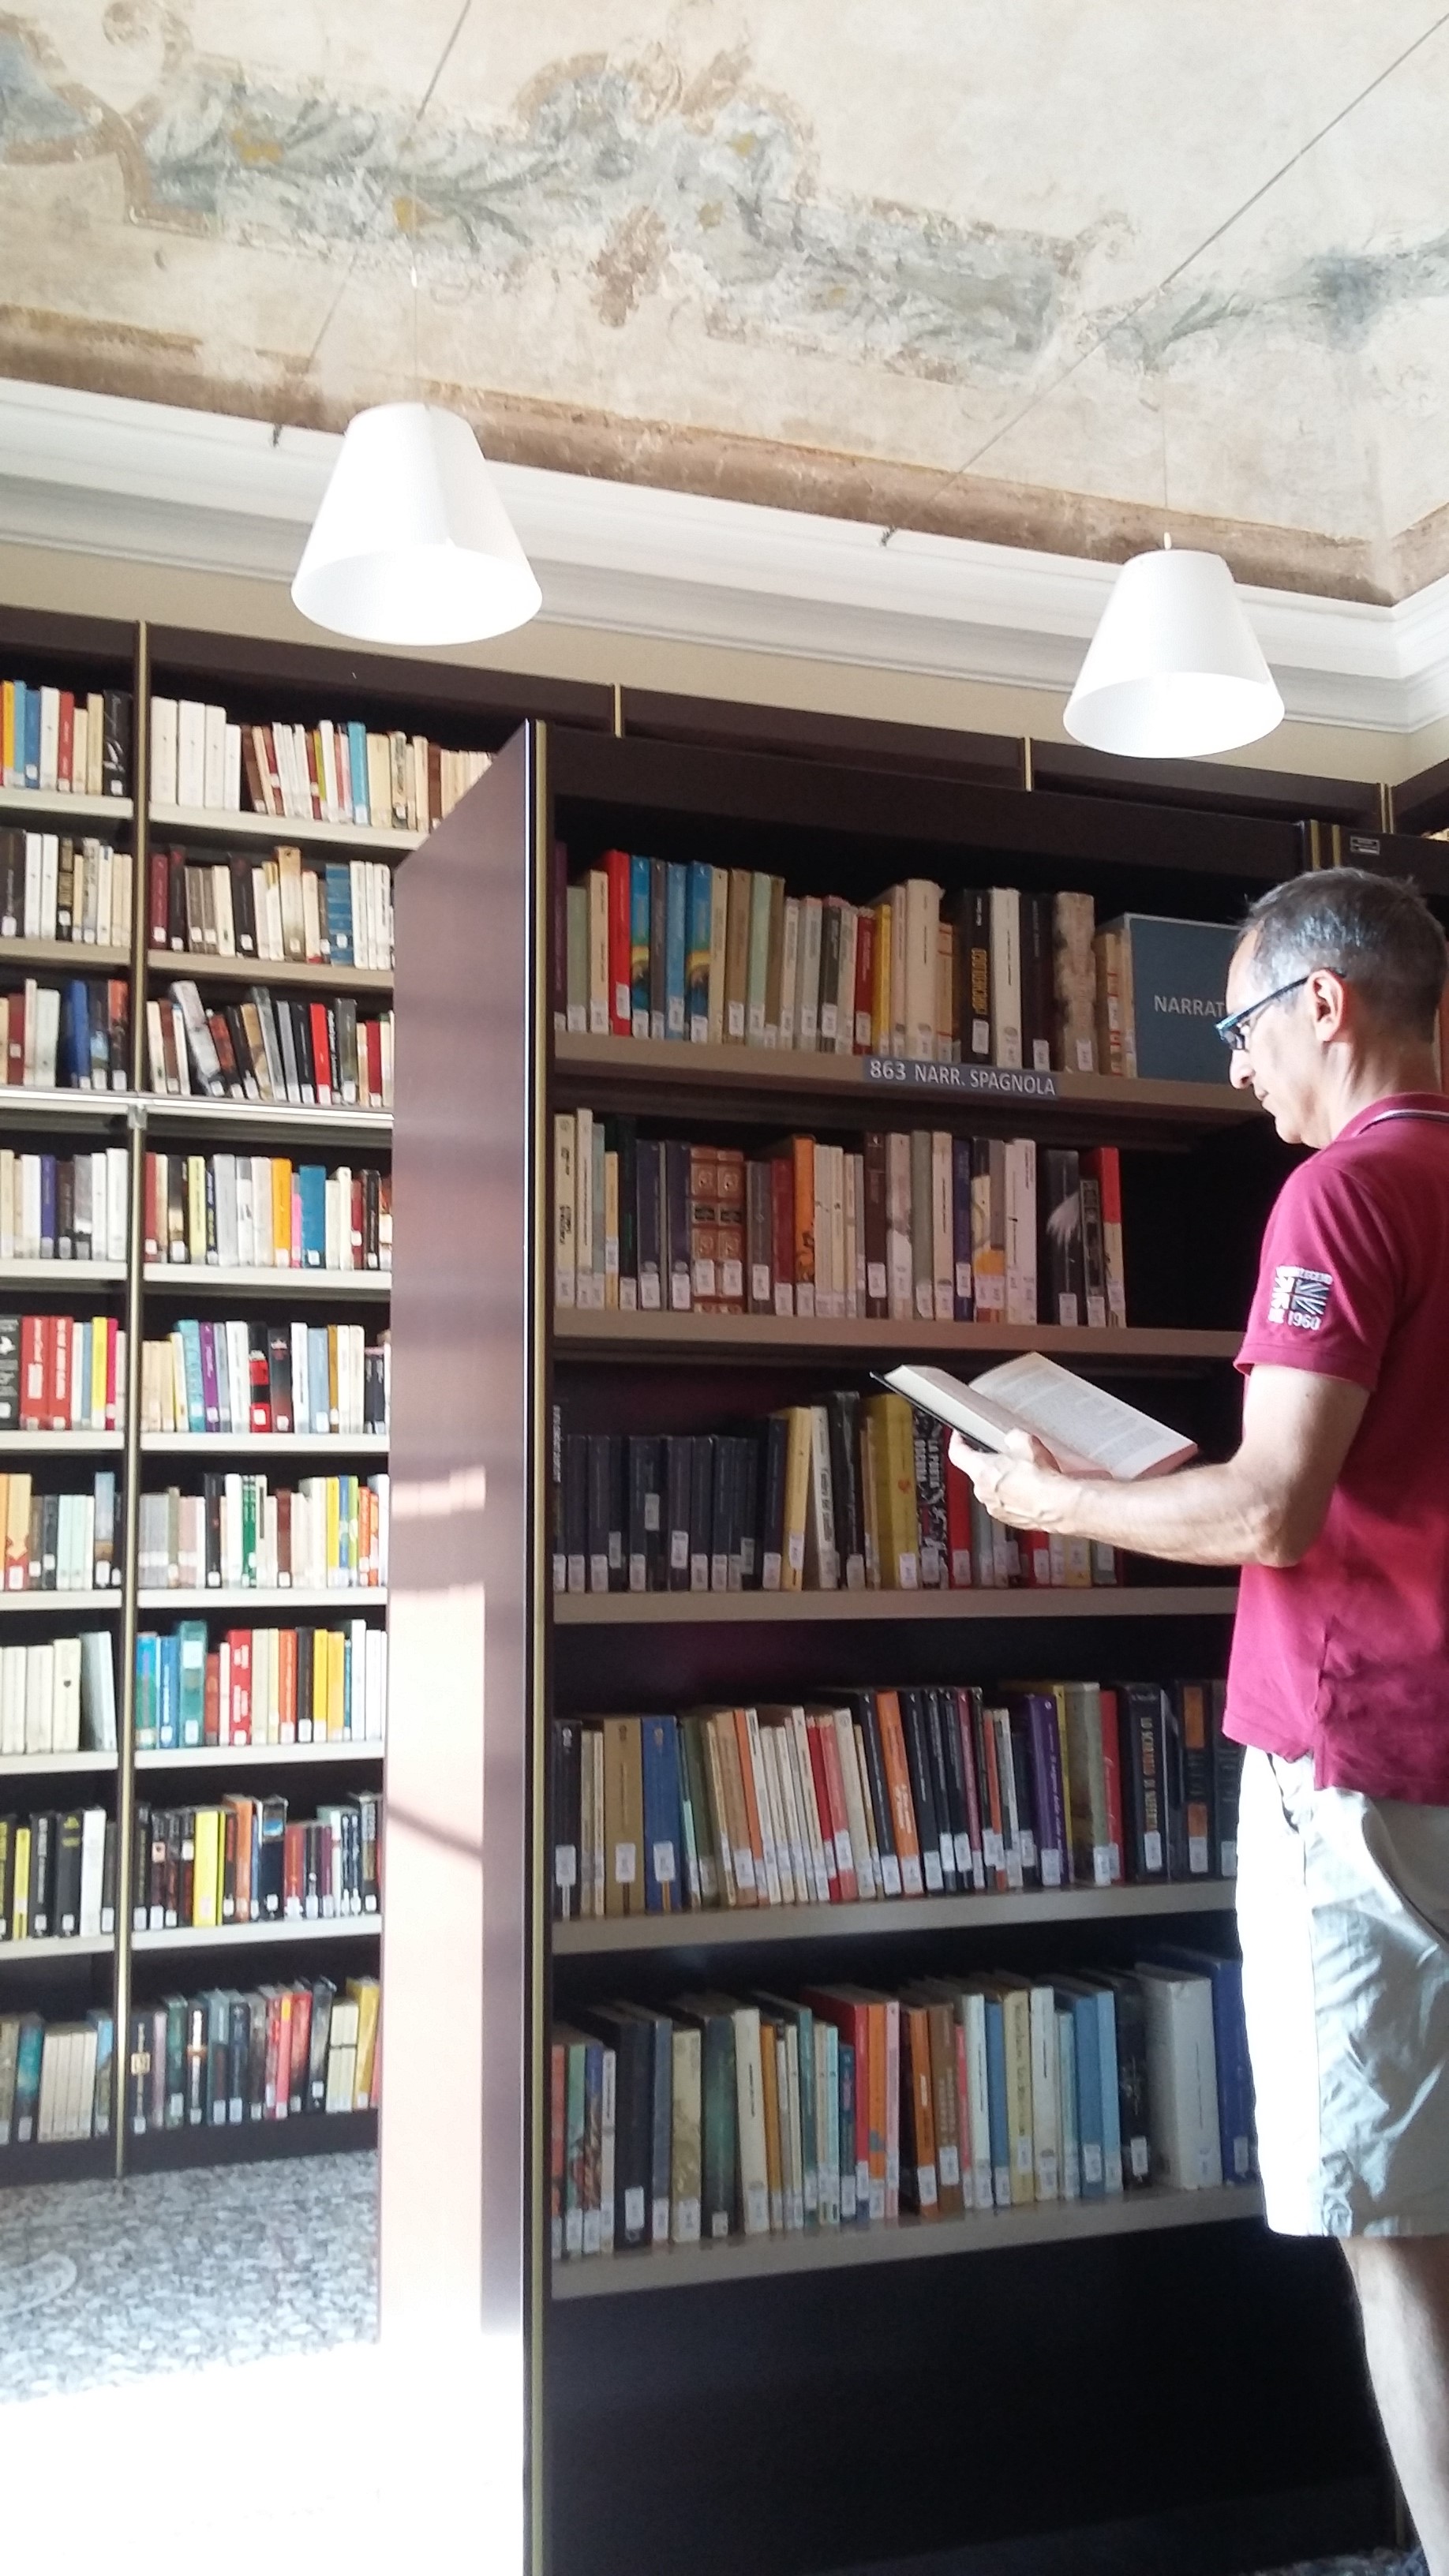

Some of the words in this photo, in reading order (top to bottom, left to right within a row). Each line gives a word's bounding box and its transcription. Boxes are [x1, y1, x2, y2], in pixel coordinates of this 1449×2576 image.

[870, 1059, 907, 1081] 863
[914, 1063, 965, 1087] NARR.
[970, 1068, 1056, 1096] SPAGNOLA
[1287, 1310, 1321, 1331] 1960
